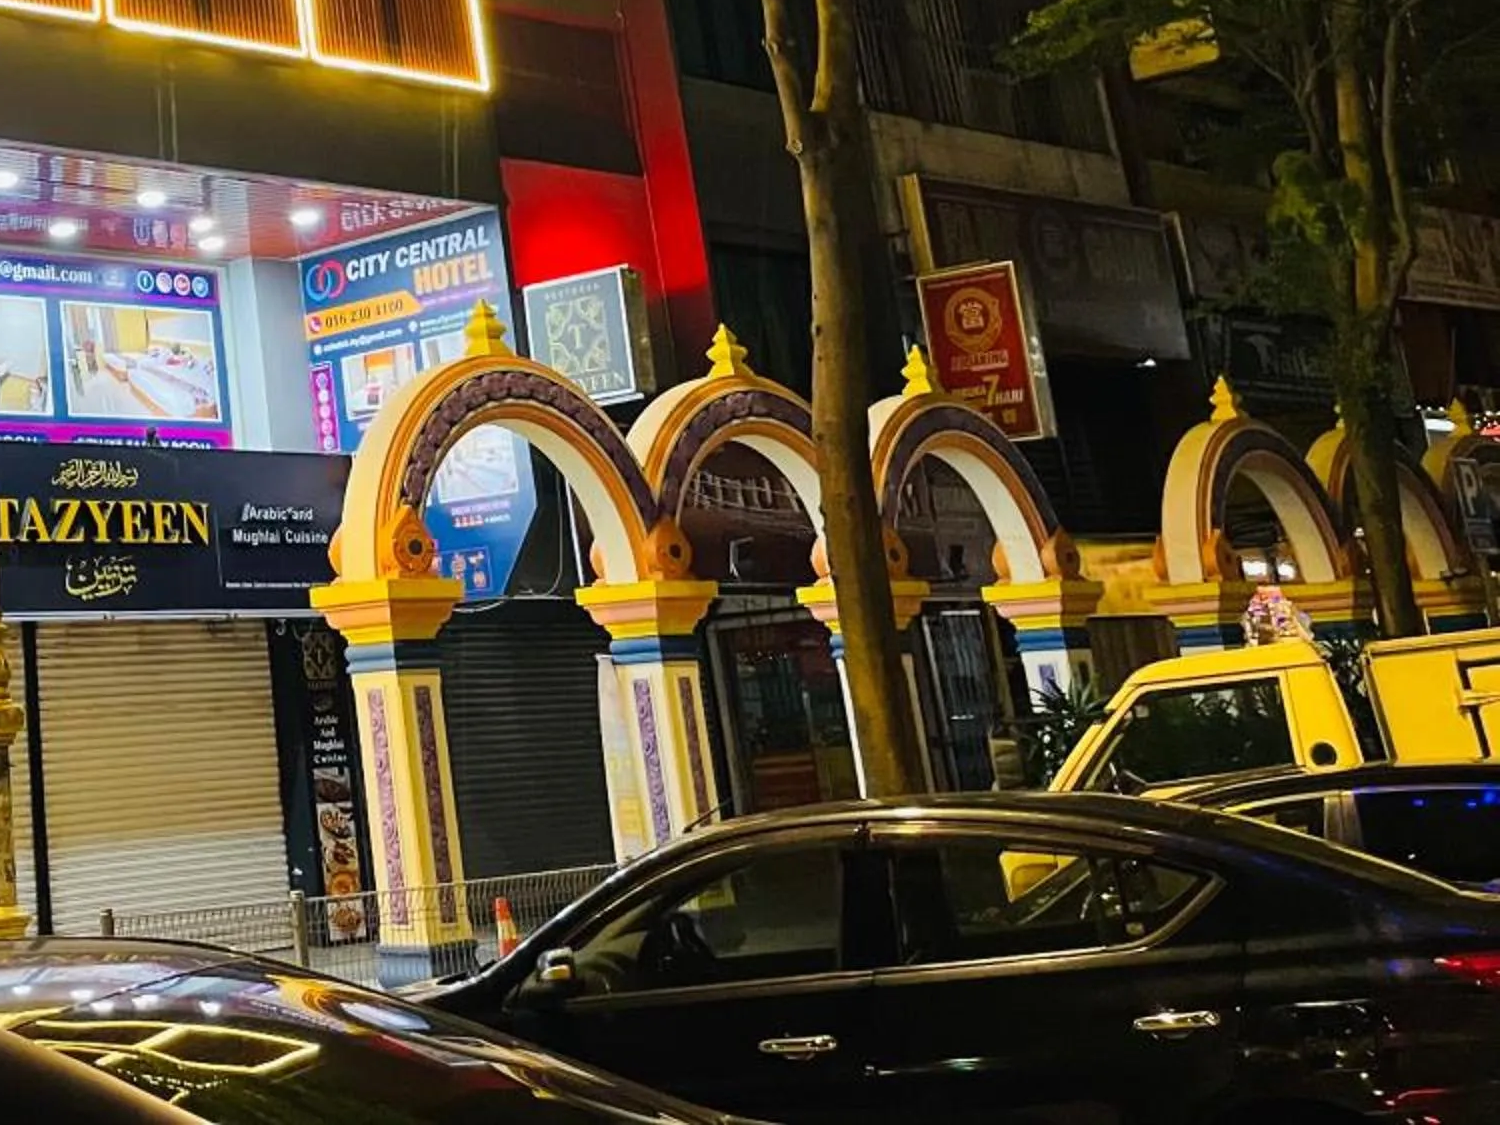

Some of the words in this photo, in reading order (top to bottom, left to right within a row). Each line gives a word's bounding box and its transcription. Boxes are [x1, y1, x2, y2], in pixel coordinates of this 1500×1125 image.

[345, 251, 390, 281] CITY
[395, 226, 490, 268] CENTRAL
[413, 252, 493, 296] HOTEL
[982, 374, 1000, 407] 7
[232, 528, 280, 546] Mughlai
